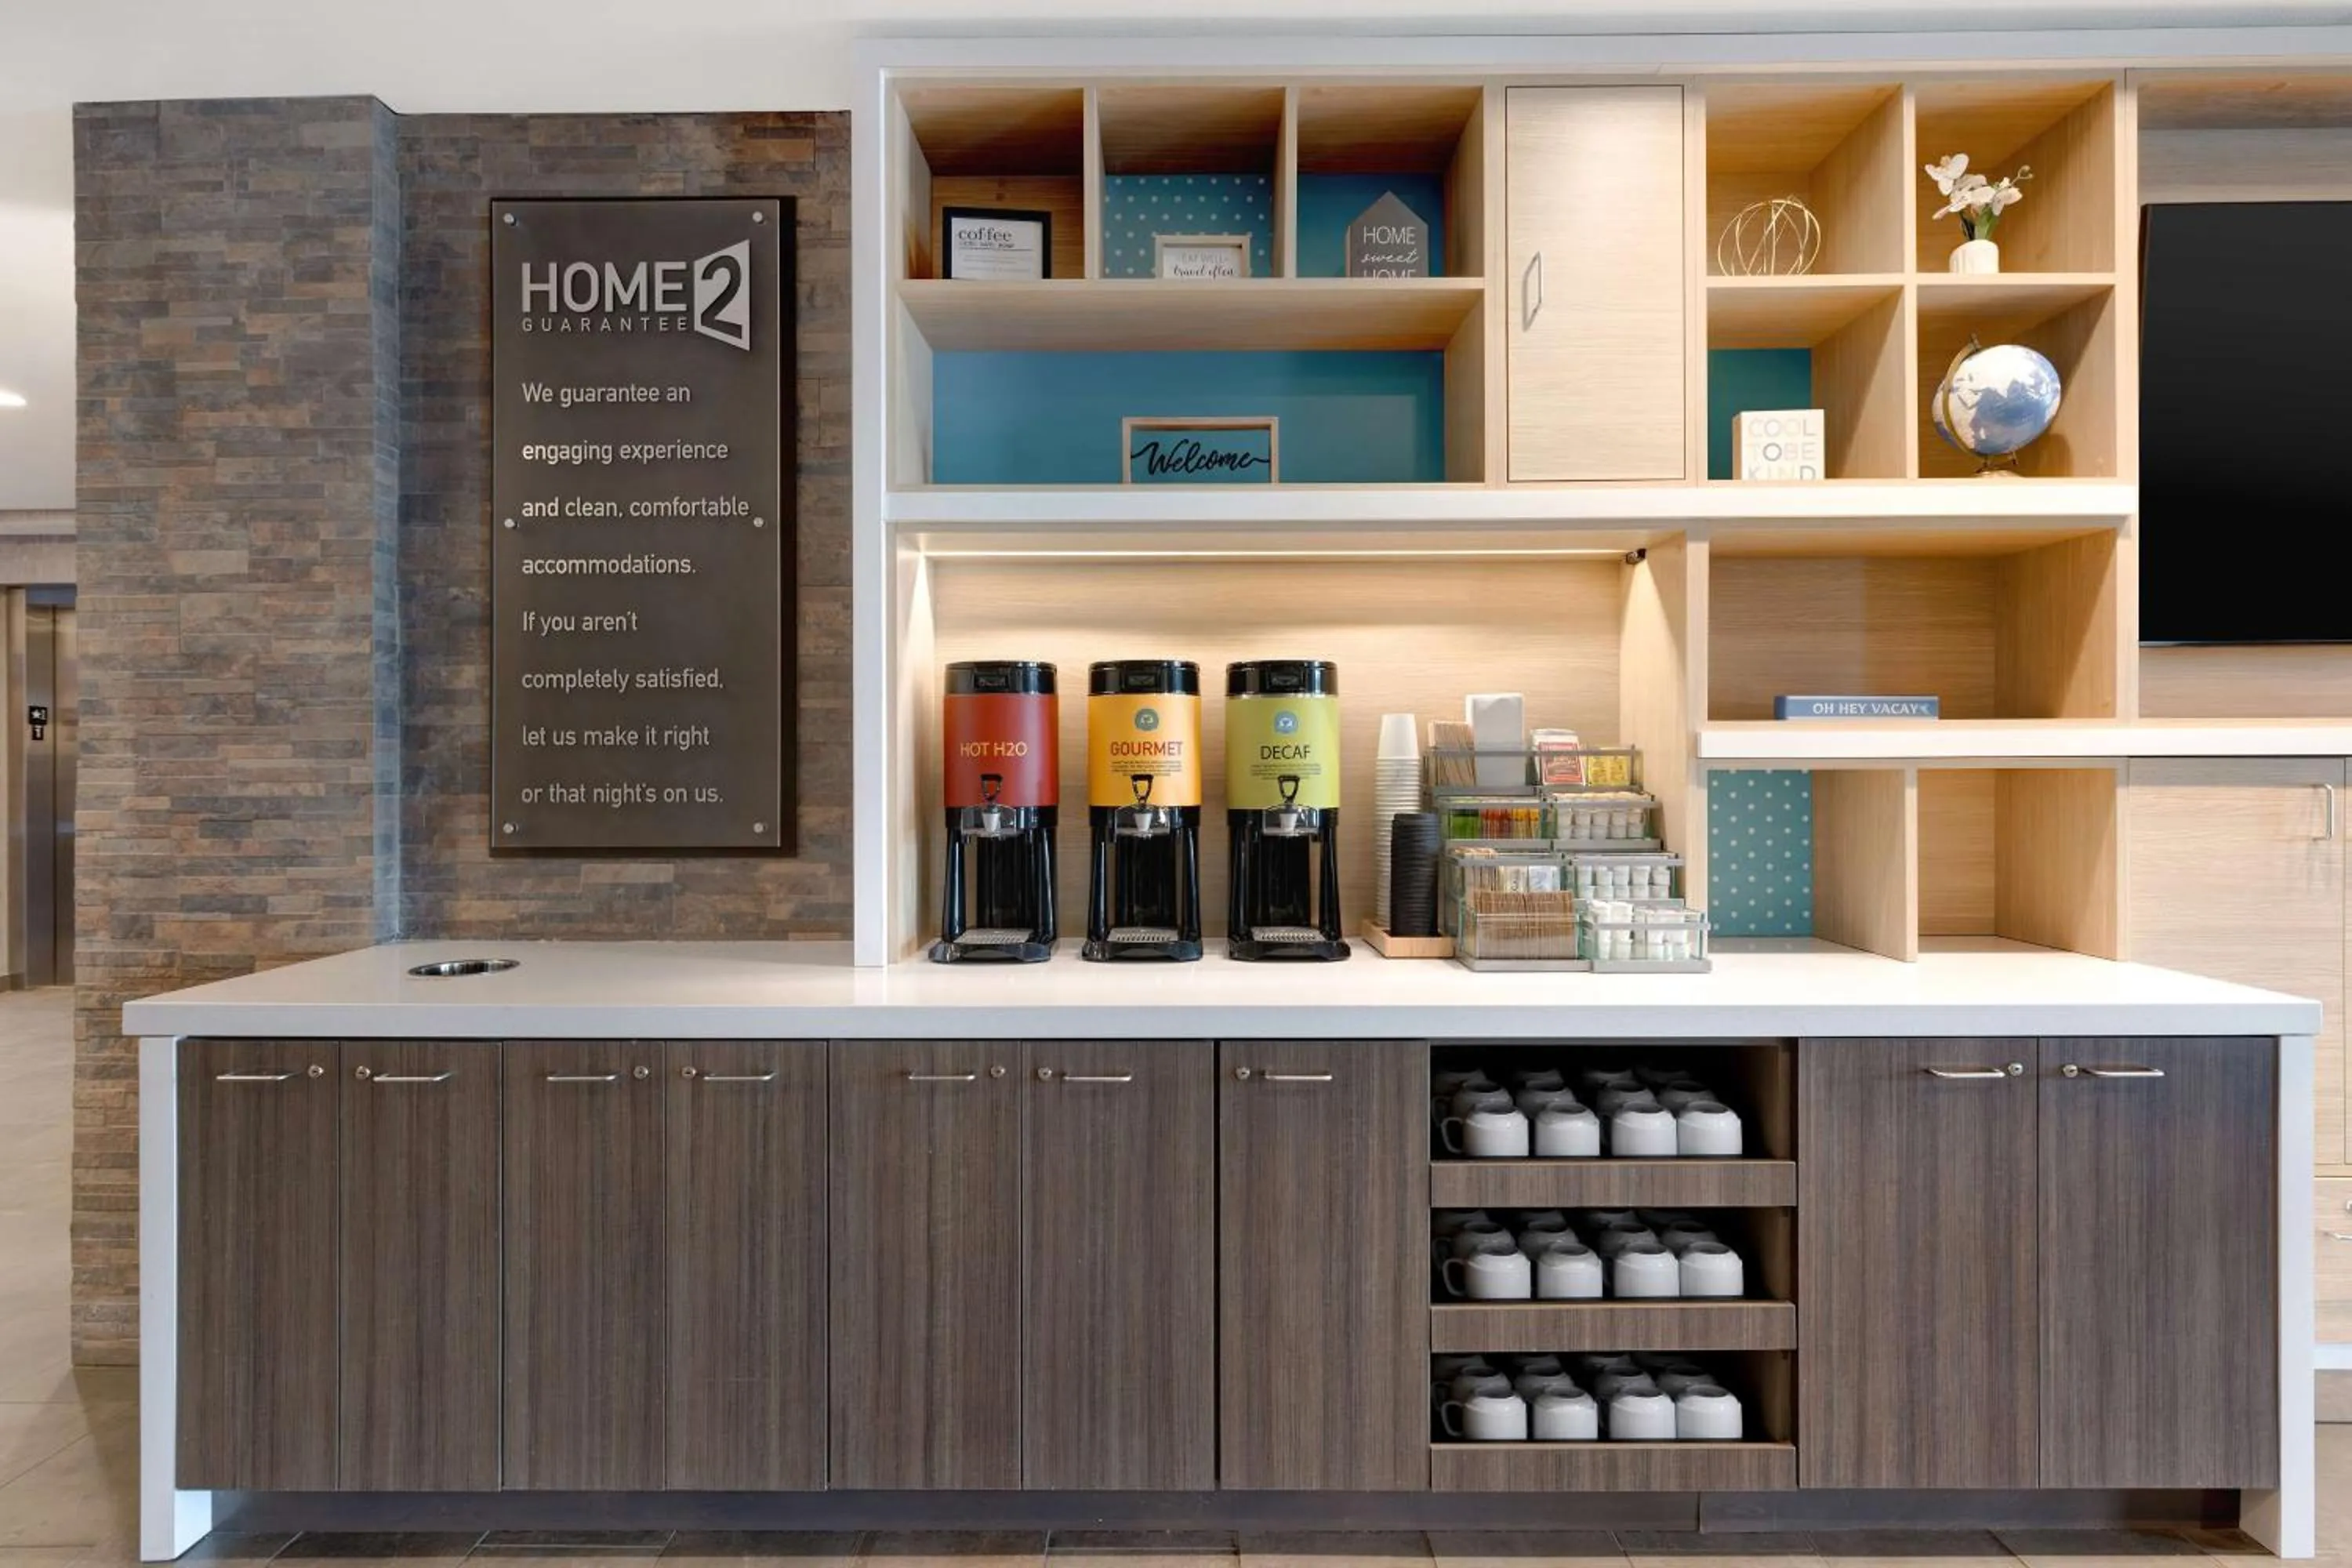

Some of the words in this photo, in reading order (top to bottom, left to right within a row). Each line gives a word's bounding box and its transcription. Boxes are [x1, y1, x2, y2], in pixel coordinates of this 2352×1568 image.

[1363, 225, 1416, 245] HOME
[1361, 248, 1418, 263] sweet
[521, 261, 688, 313] HOME
[521, 316, 688, 332] GUARANTEE
[521, 382, 554, 403] We
[560, 382, 660, 408] guarantee
[666, 387, 691, 403] an
[1748, 419, 1817, 437] COOL
[521, 439, 613, 465] engaging
[619, 439, 729, 465] experience
[1131, 438, 1270, 475] Welcome
[521, 495, 559, 517] and
[630, 495, 750, 517] comfortable
[521, 553, 697, 575] accommodations.
[523, 611, 536, 632] If
[539, 615, 575, 637] you
[521, 667, 630, 694] completely
[1812, 702, 1835, 715] OH
[1838, 702, 1867, 715] HEY
[1871, 702, 1918, 715] VACAY
[522, 725, 546, 746] let
[552, 730, 577, 746] us
[583, 724, 640, 746] make
[645, 725, 658, 746] it
[664, 724, 710, 751] right
[1110, 740, 1183, 757] GOURMET
[960, 741, 989, 757] HOT
[993, 741, 1029, 757] H2O
[1260, 744, 1311, 760] DECAF
[521, 788, 543, 804] or
[549, 782, 586, 804] that
[593, 782, 657, 808] night's
[663, 787, 688, 804] on
[695, 787, 724, 804] us.
